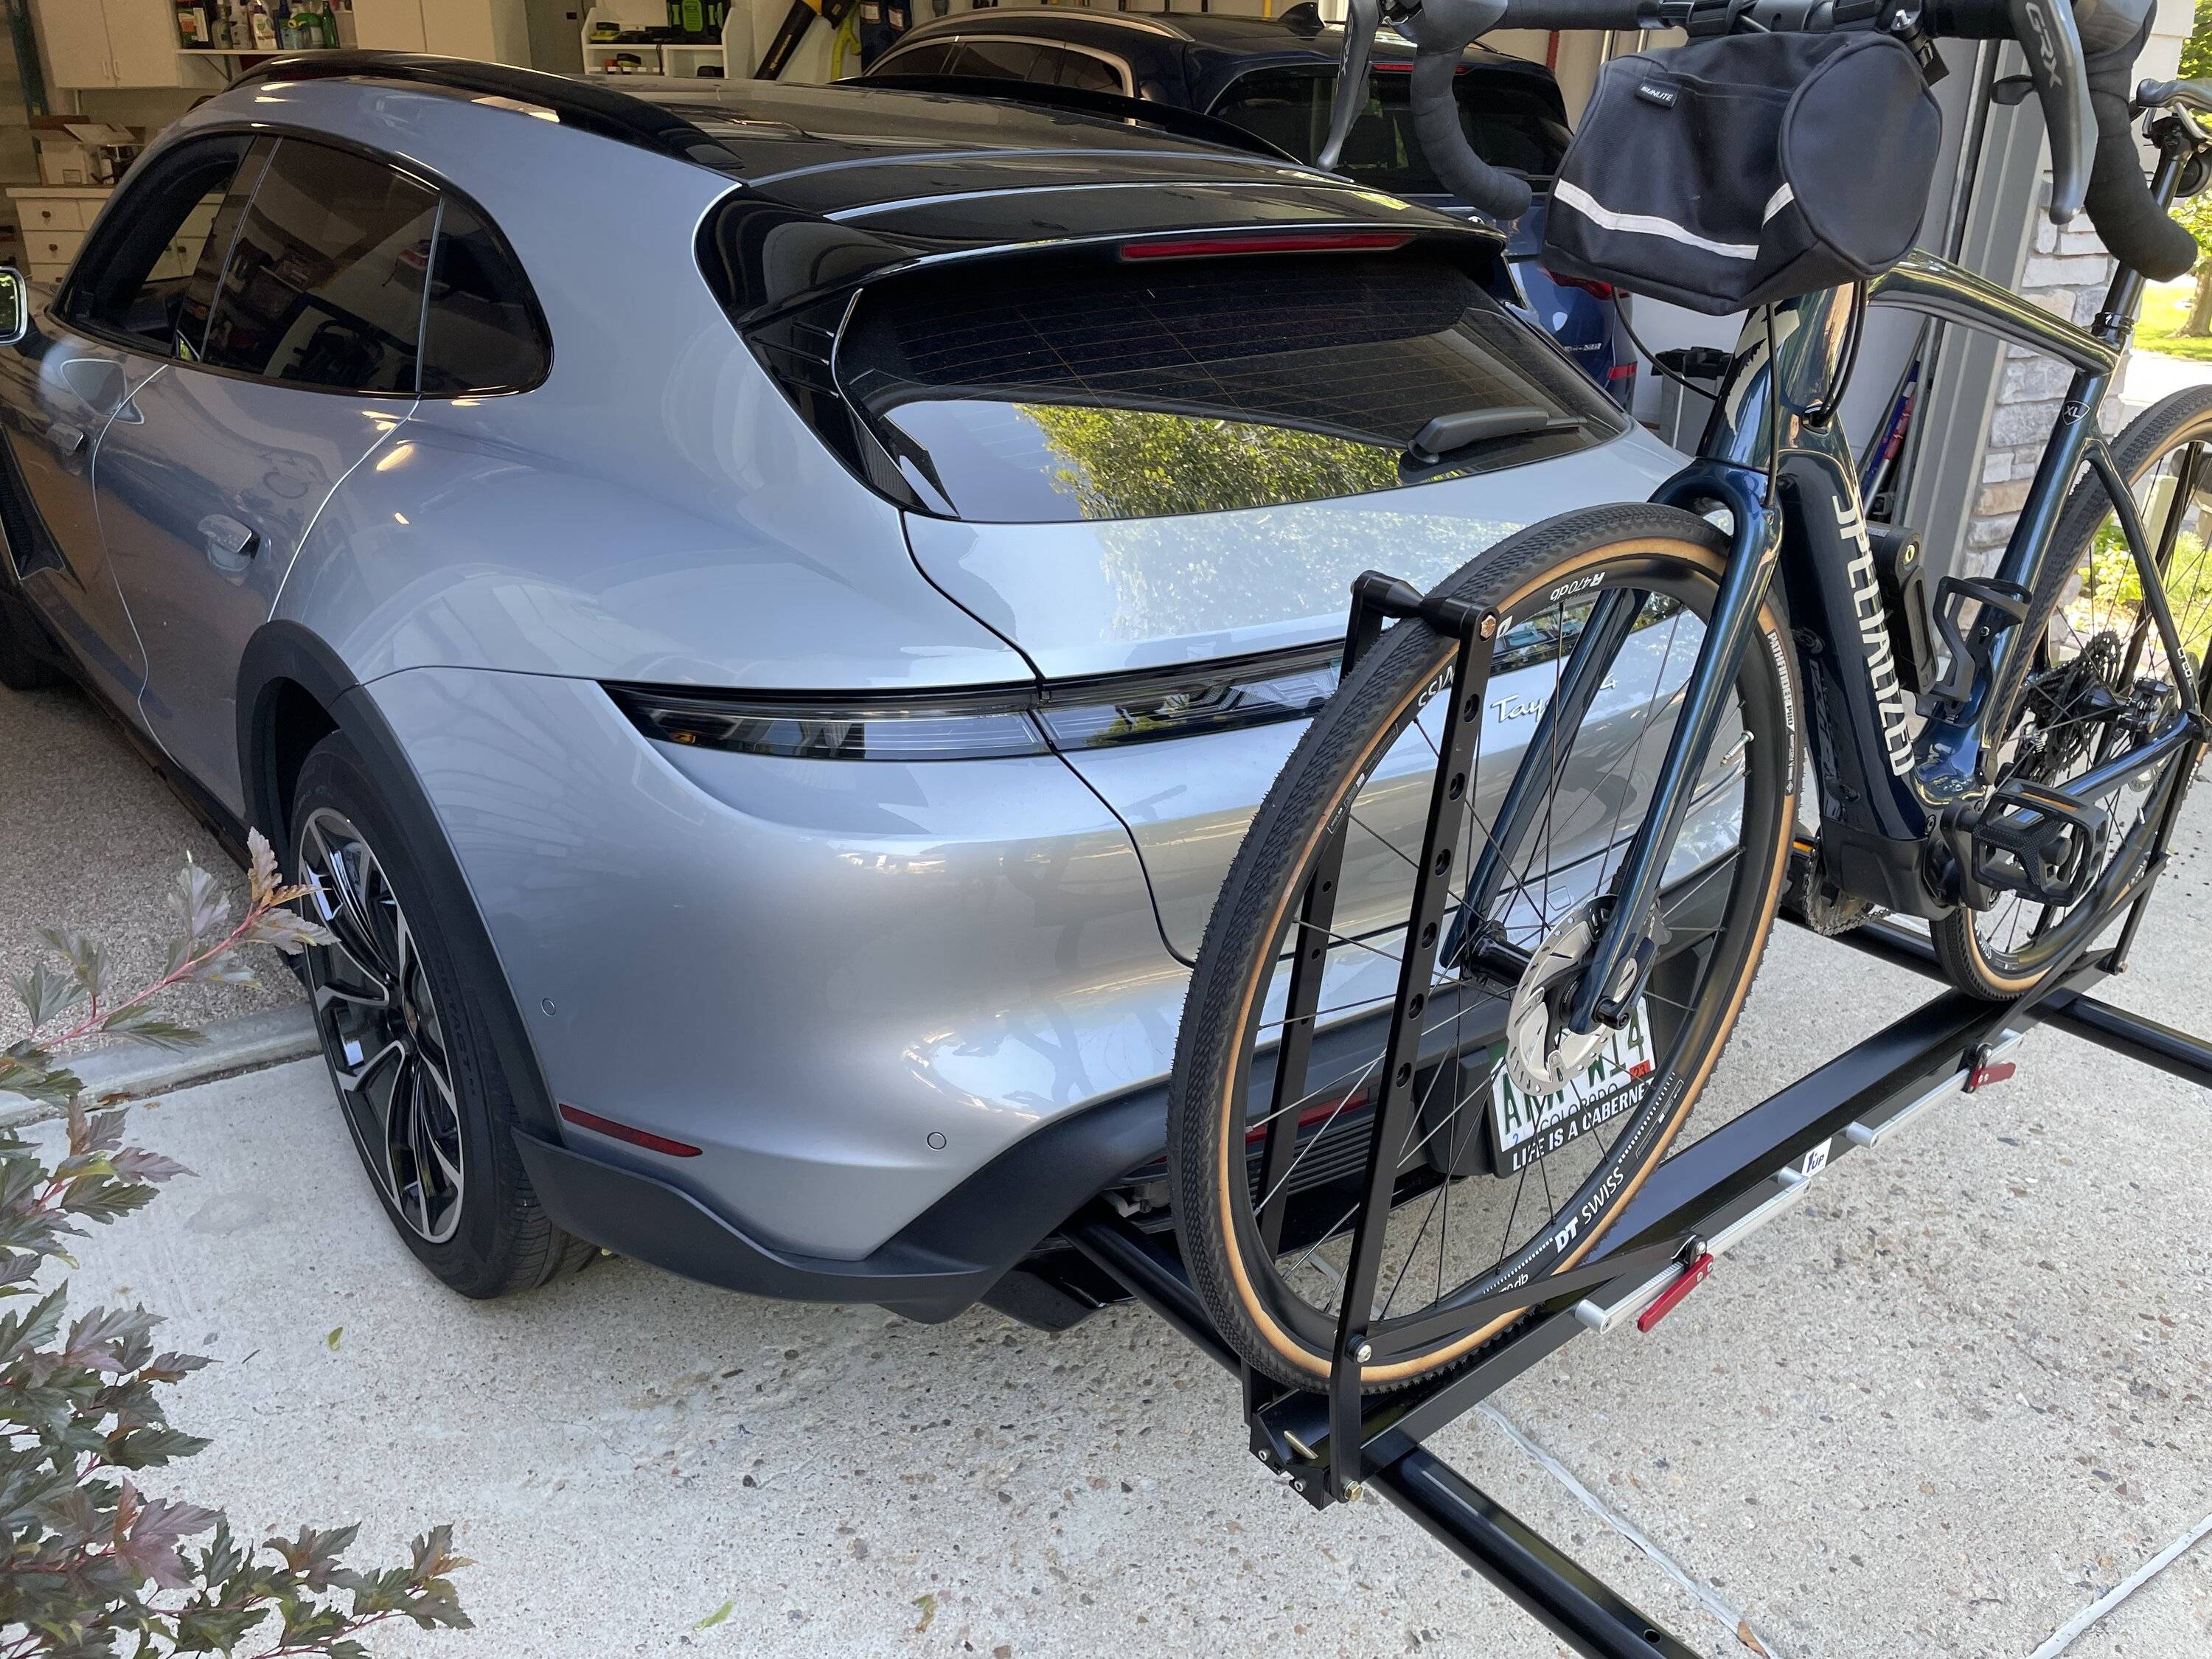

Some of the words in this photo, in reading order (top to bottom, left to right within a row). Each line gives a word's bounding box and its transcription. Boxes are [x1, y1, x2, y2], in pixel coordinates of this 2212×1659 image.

[2025, 1, 2062, 88] GRX
[2064, 406, 2080, 418] XL
[1767, 632, 1793, 706] PATHFINDER
[1512, 1137, 1545, 1172] LIFE
[1548, 1128, 1564, 1151] IS
[1568, 1120, 1579, 1141] A
[1554, 1216, 1579, 1253] DT
[1582, 1166, 1624, 1225] SWISS
